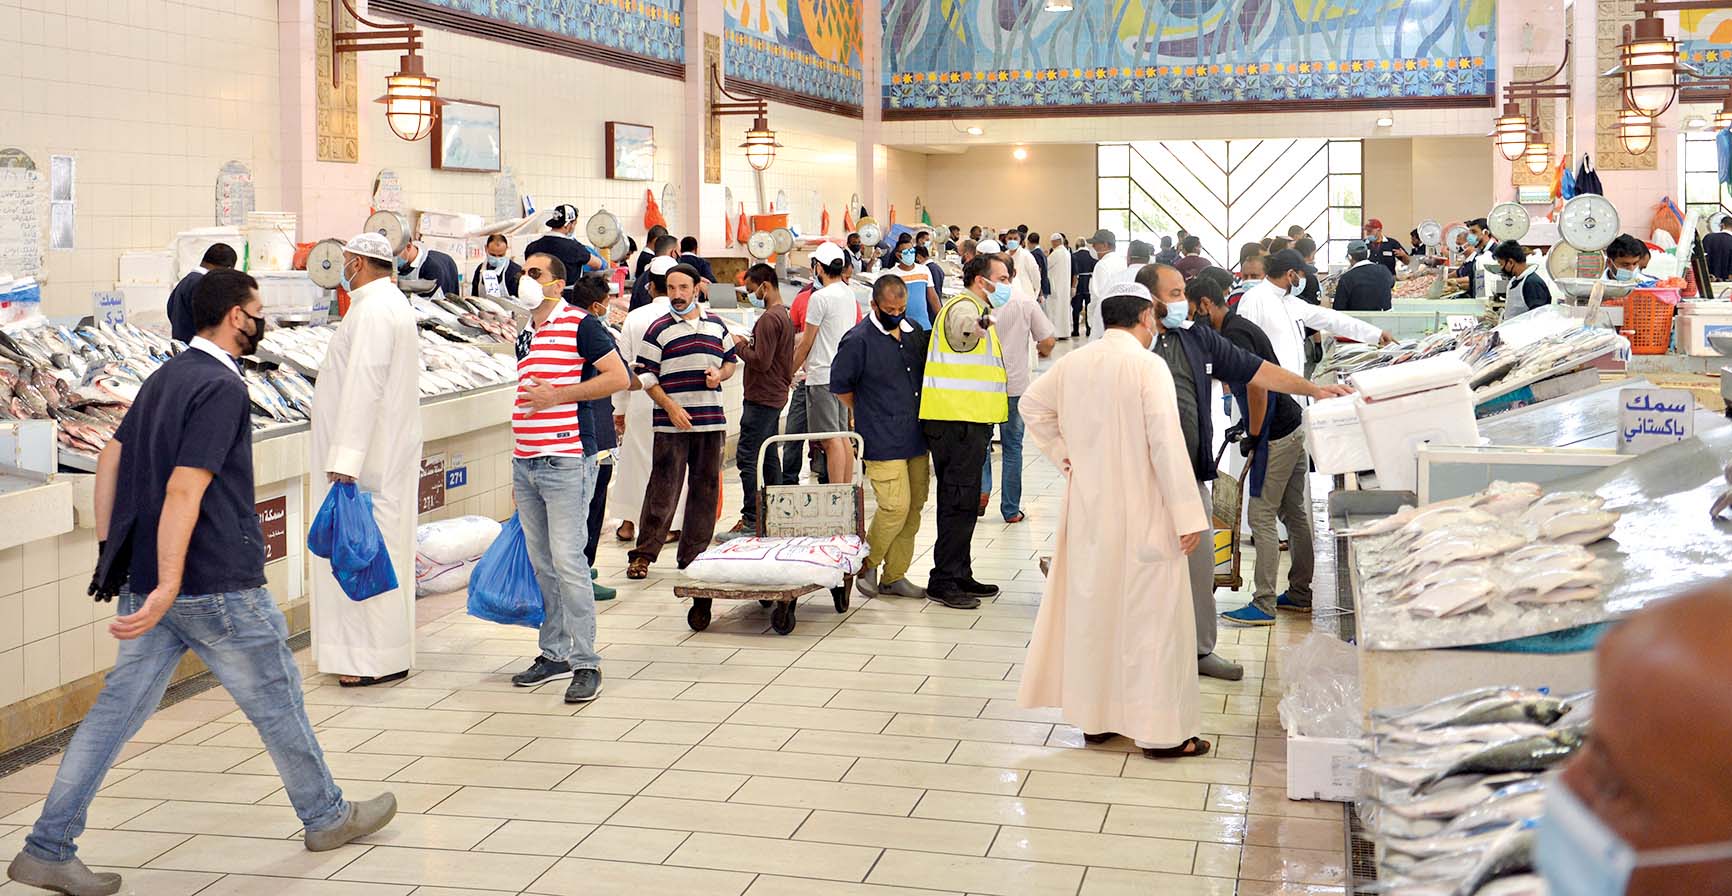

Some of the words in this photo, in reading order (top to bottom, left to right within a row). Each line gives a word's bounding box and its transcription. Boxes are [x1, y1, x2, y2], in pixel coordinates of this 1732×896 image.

[1626, 394, 1686, 413] سمك
[1624, 417, 1685, 442] باكستاني
[449, 471, 463, 486] 271
